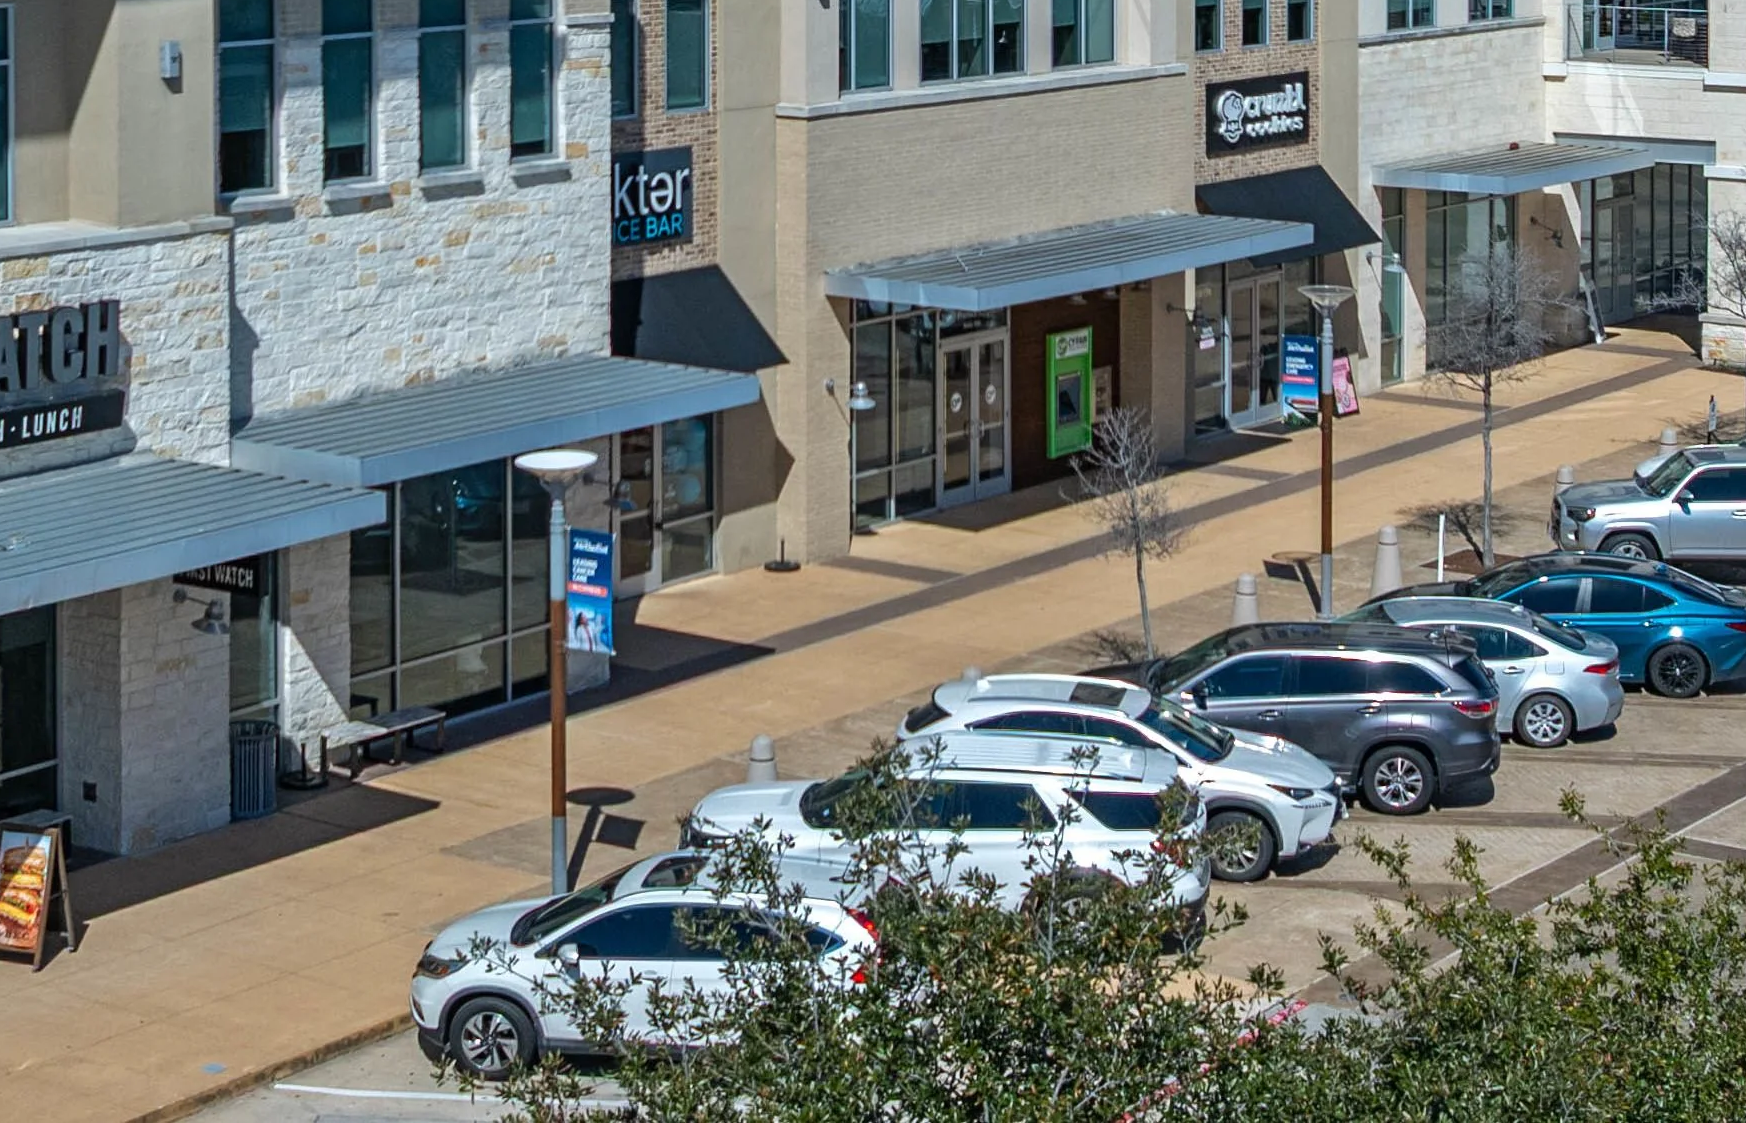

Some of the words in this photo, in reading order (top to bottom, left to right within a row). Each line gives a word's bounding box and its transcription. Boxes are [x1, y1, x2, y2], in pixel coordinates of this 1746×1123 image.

[646, 213, 683, 238] BAR
[21, 405, 83, 439] LUNCH
[215, 564, 253, 589] WATCH
